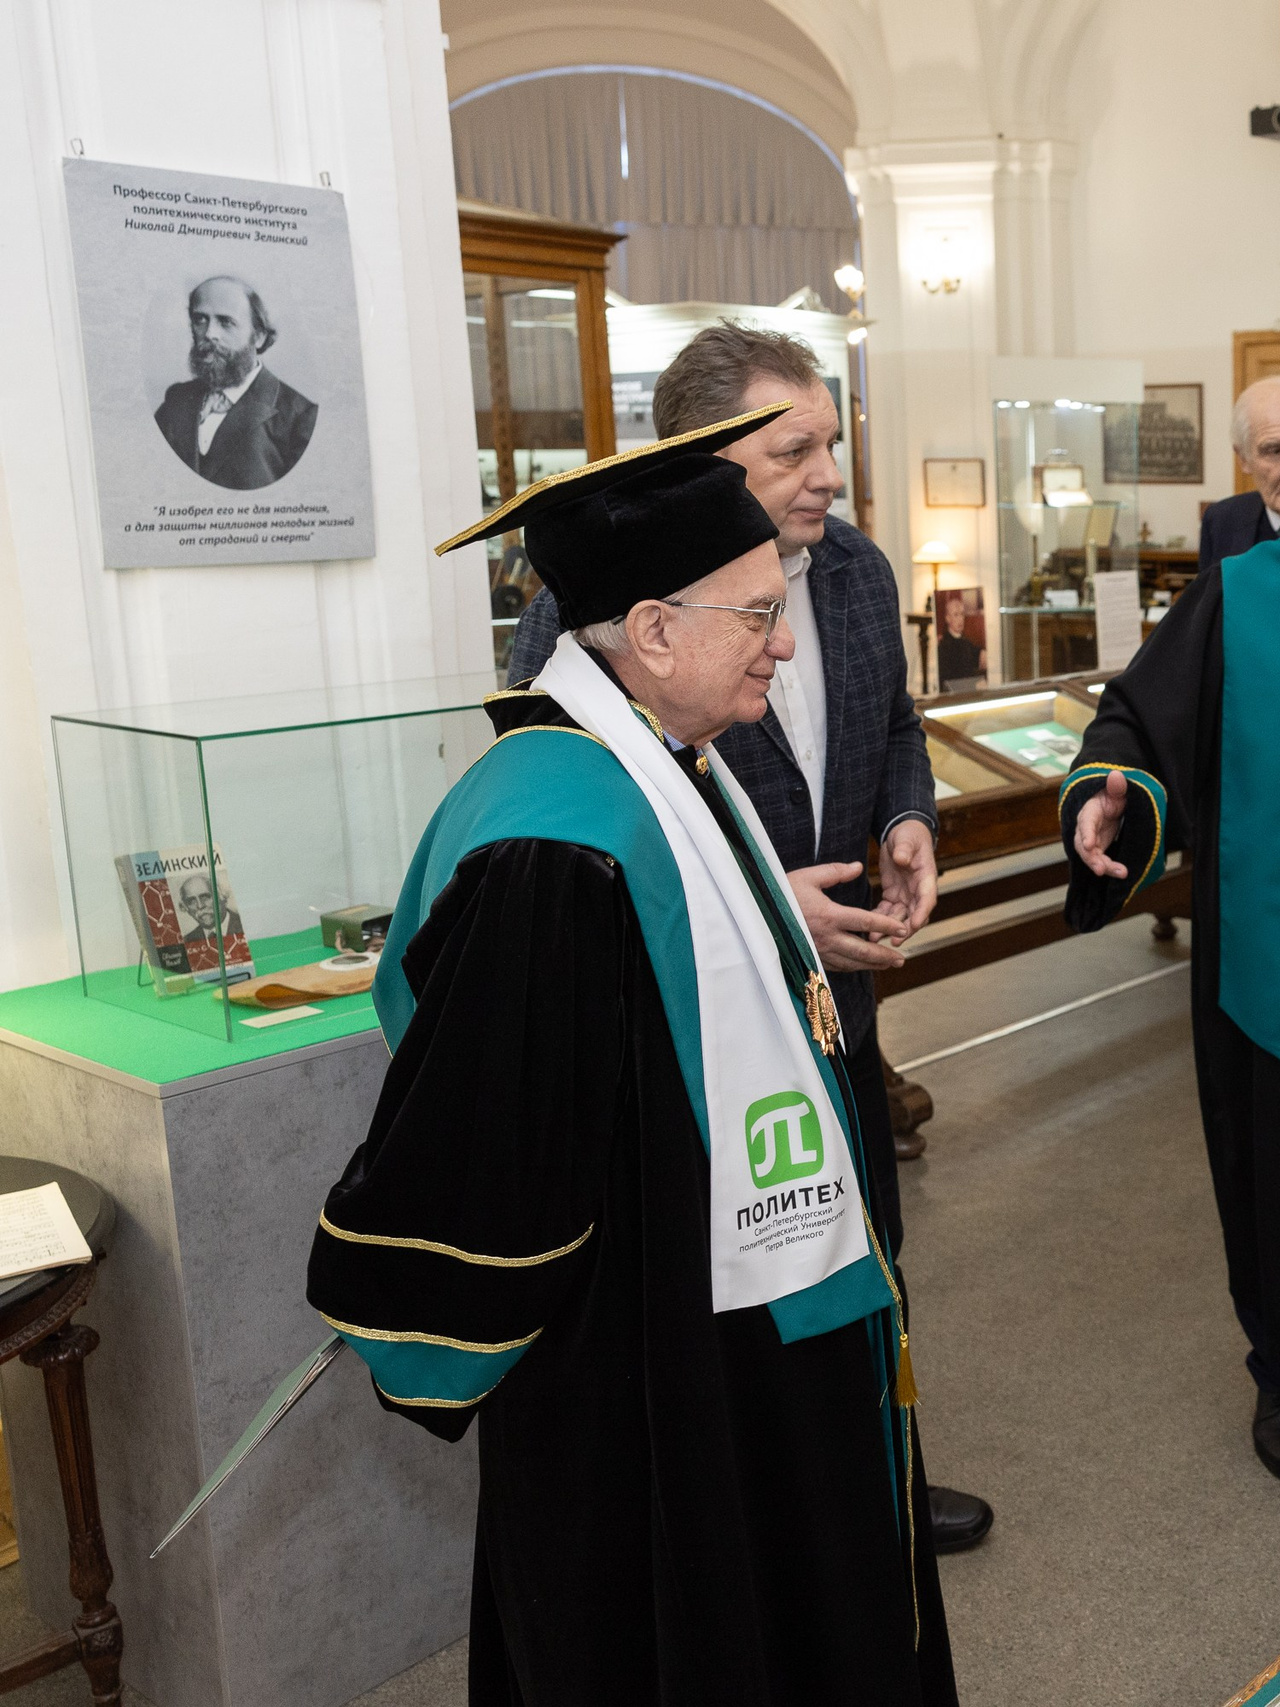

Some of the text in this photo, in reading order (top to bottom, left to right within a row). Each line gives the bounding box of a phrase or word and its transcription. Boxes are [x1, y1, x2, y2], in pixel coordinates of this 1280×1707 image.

[113, 184, 308, 216] Профессор Санкт-Петербургского
[133, 204, 298, 231] политехнического института
[124, 218, 308, 246] Николай Дмитриевич Зелинский
[169, 506, 214, 518] изобрел
[216, 506, 234, 516] его
[237, 506, 249, 515] не
[252, 504, 271, 515] для
[273, 503, 330, 515] нападения,
[124, 516, 355, 533] а для защиты миллионов молодых жизней
[178, 536, 196, 546] от
[199, 533, 259, 546] страданий
[261, 534, 268, 543] и
[737, 1176, 845, 1230] ПОЛИТЕХ
[739, 1209, 847, 1253] политехнический Университет
[754, 1206, 833, 1237] Санкт-Петербургский
[765, 1229, 824, 1254] Петра Великого
